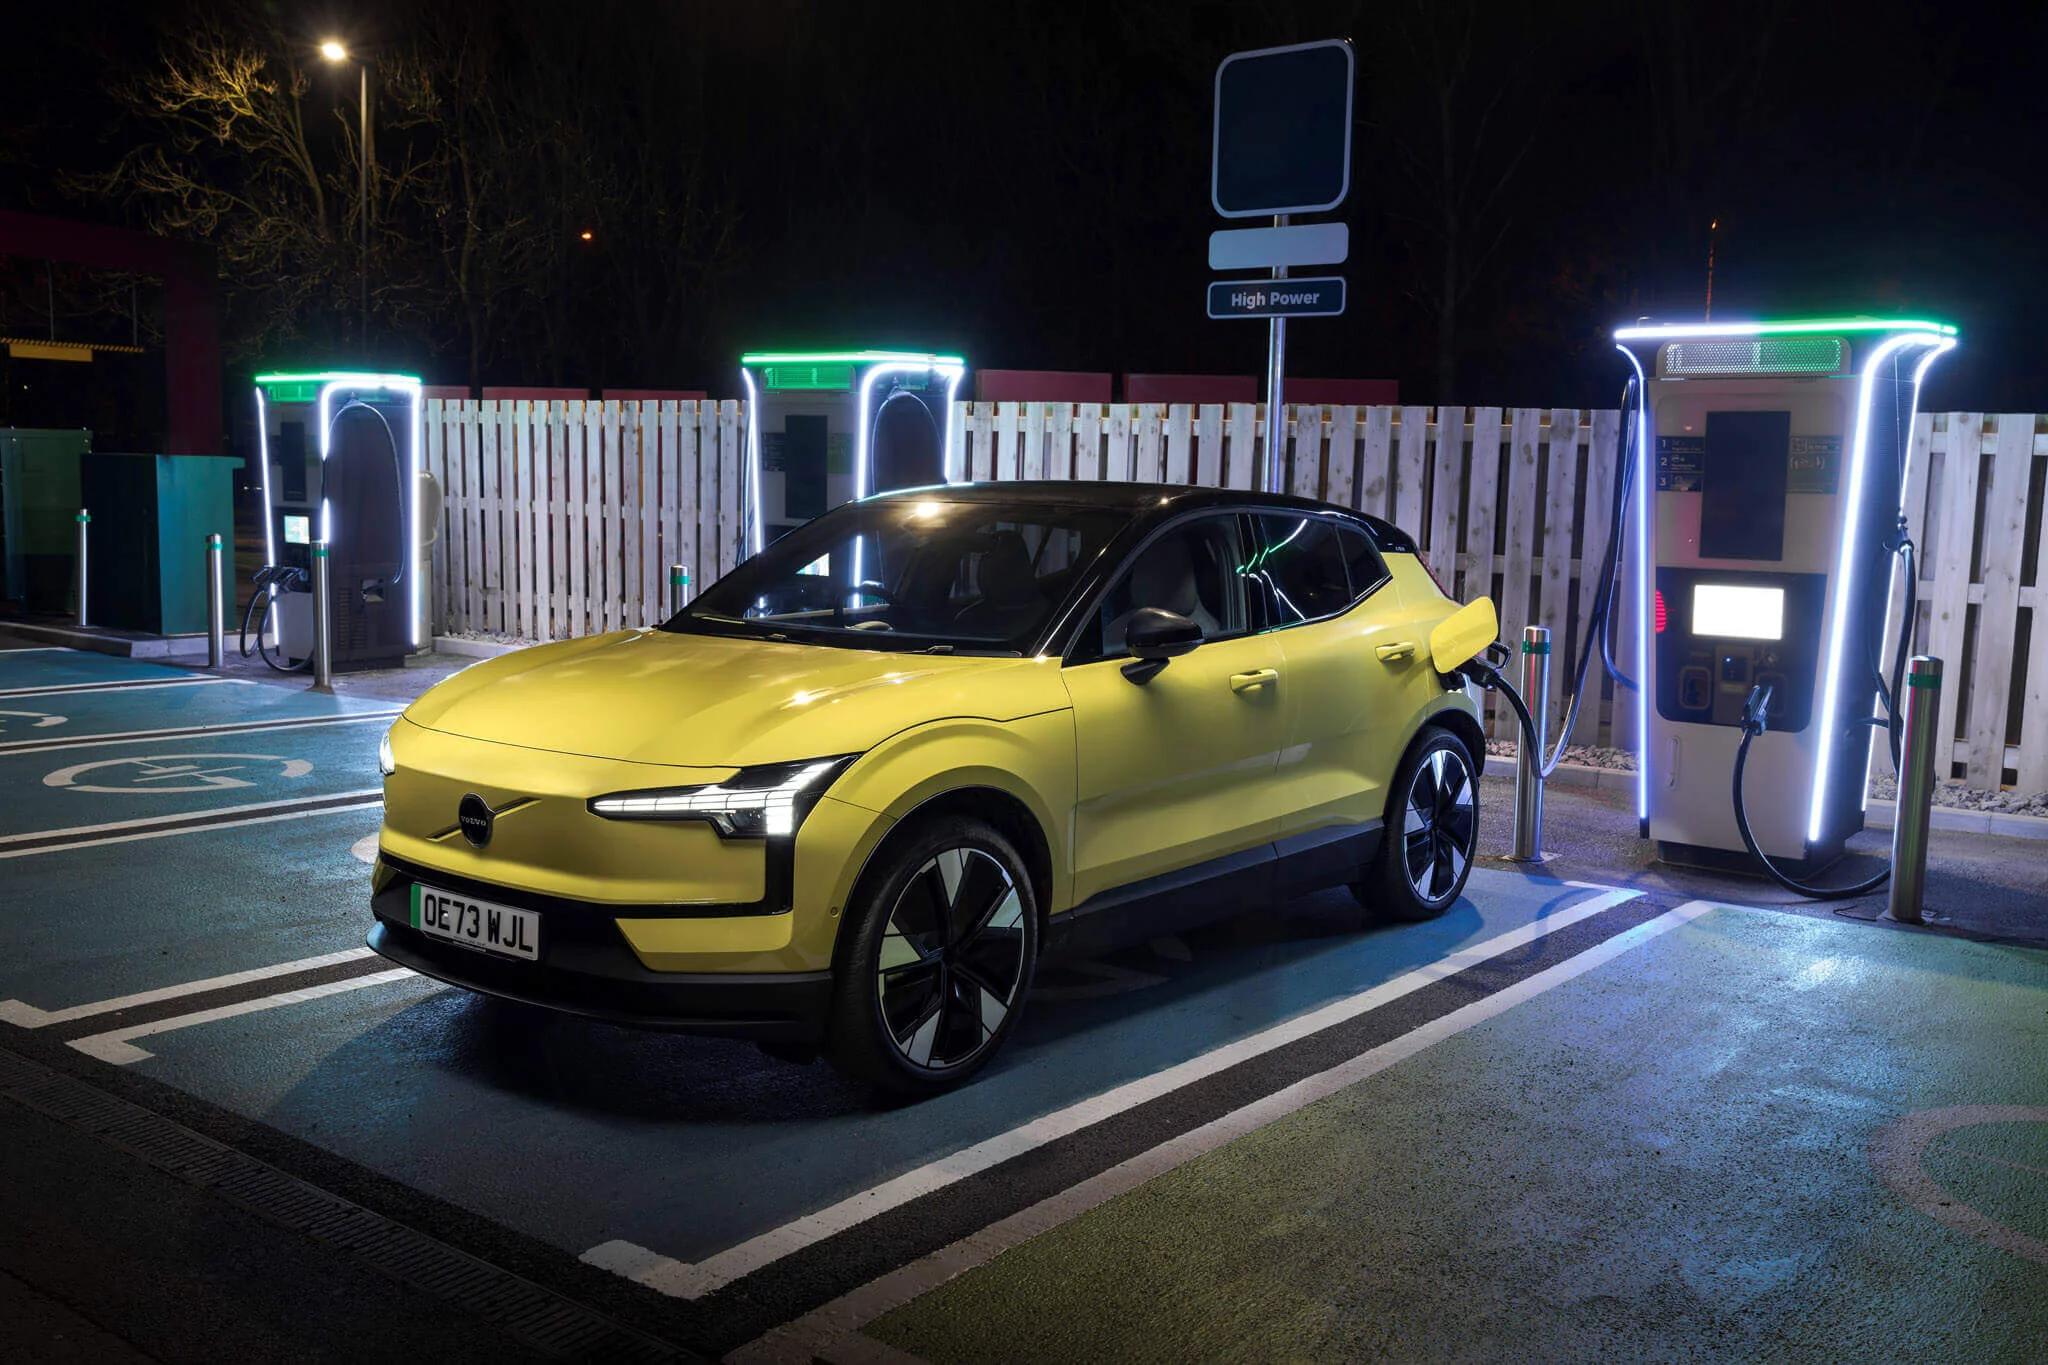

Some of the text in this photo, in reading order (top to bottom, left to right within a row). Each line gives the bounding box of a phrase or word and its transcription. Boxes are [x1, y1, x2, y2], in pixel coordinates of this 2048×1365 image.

[1231, 291, 1320, 309] High Power
[1660, 457, 1668, 467] 2
[460, 815, 487, 827] VOLVO
[424, 894, 533, 953] OE73 WJL
